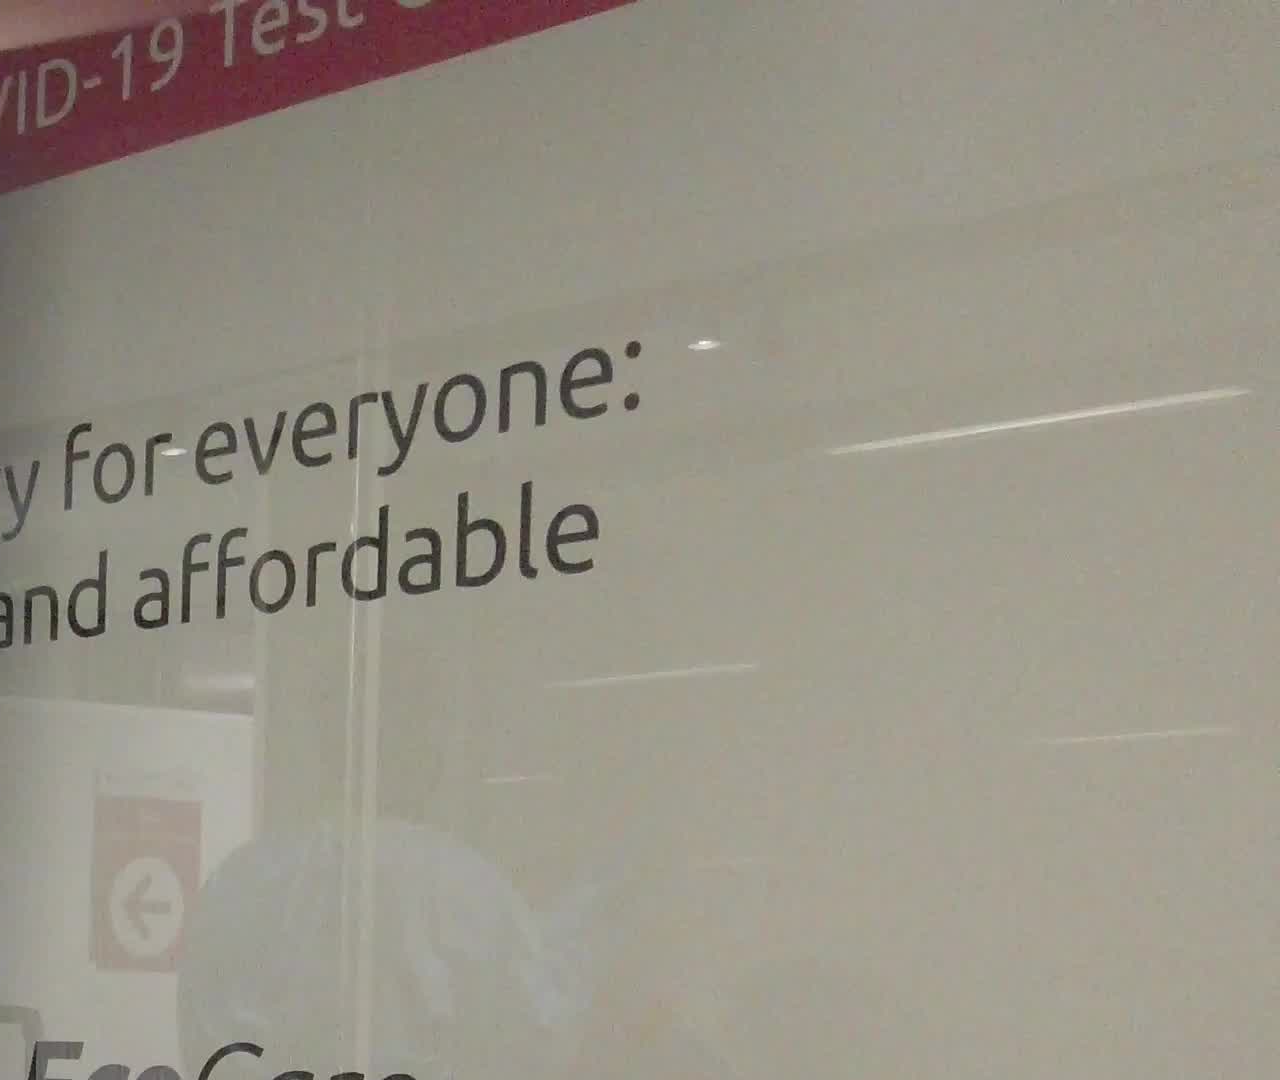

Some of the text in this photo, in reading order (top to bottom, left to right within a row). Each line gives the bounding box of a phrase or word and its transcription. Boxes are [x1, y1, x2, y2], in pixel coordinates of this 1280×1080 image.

[62, 423, 172, 511] for
[194, 339, 641, 486] everyone:
[133, 480, 600, 630] affordable
